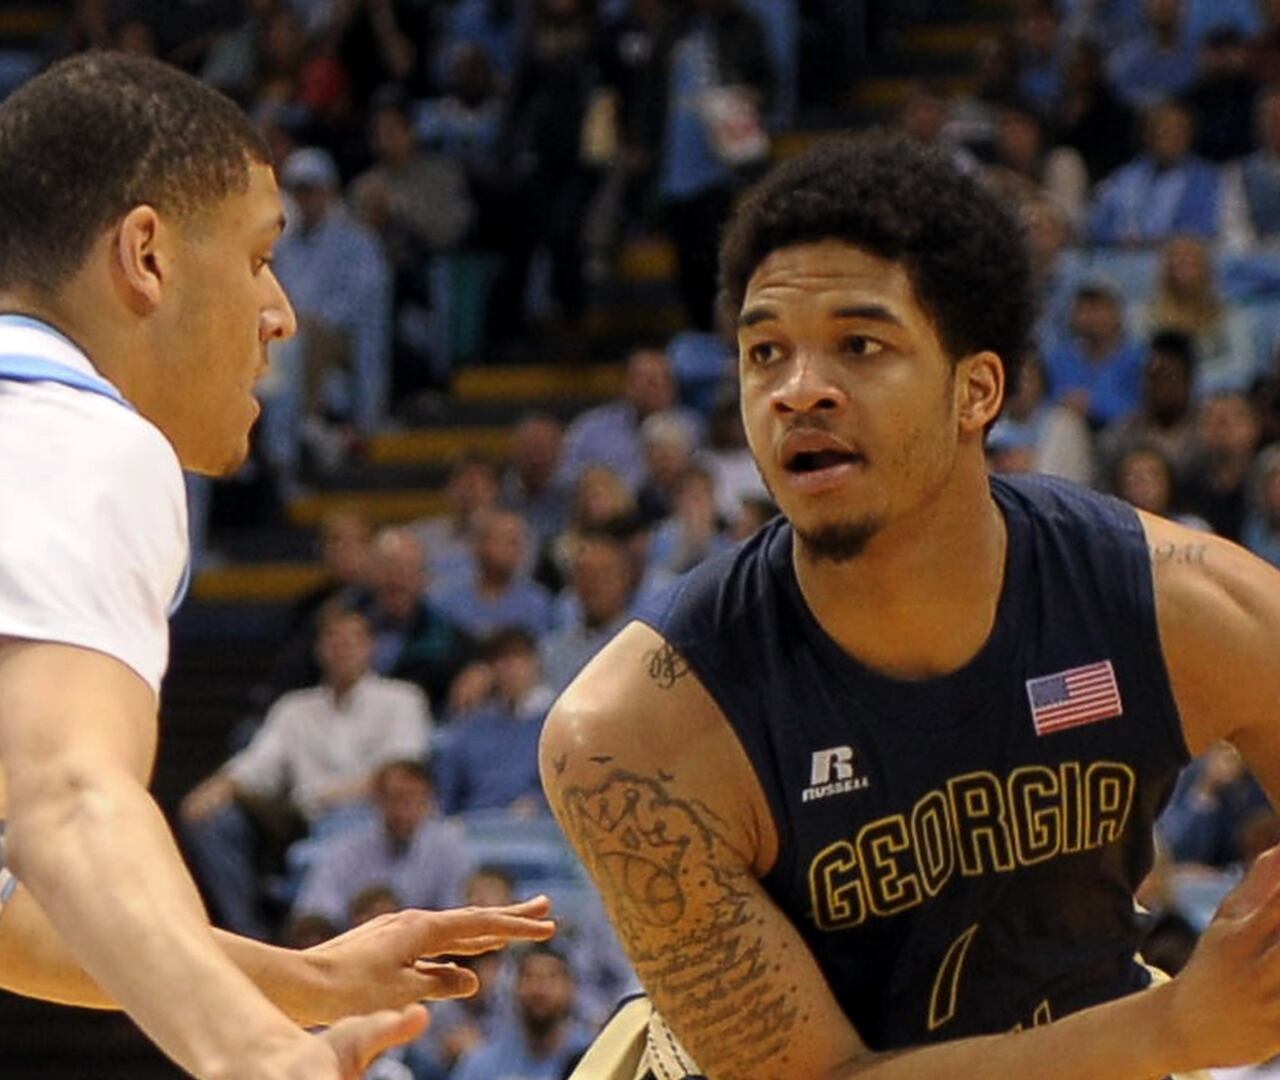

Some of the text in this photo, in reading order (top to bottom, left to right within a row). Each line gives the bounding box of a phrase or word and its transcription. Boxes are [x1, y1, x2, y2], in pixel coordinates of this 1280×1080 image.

[811, 746, 854, 785] R
[802, 777, 869, 802] RUSSELL
[809, 761, 1136, 931] GEORGIA
